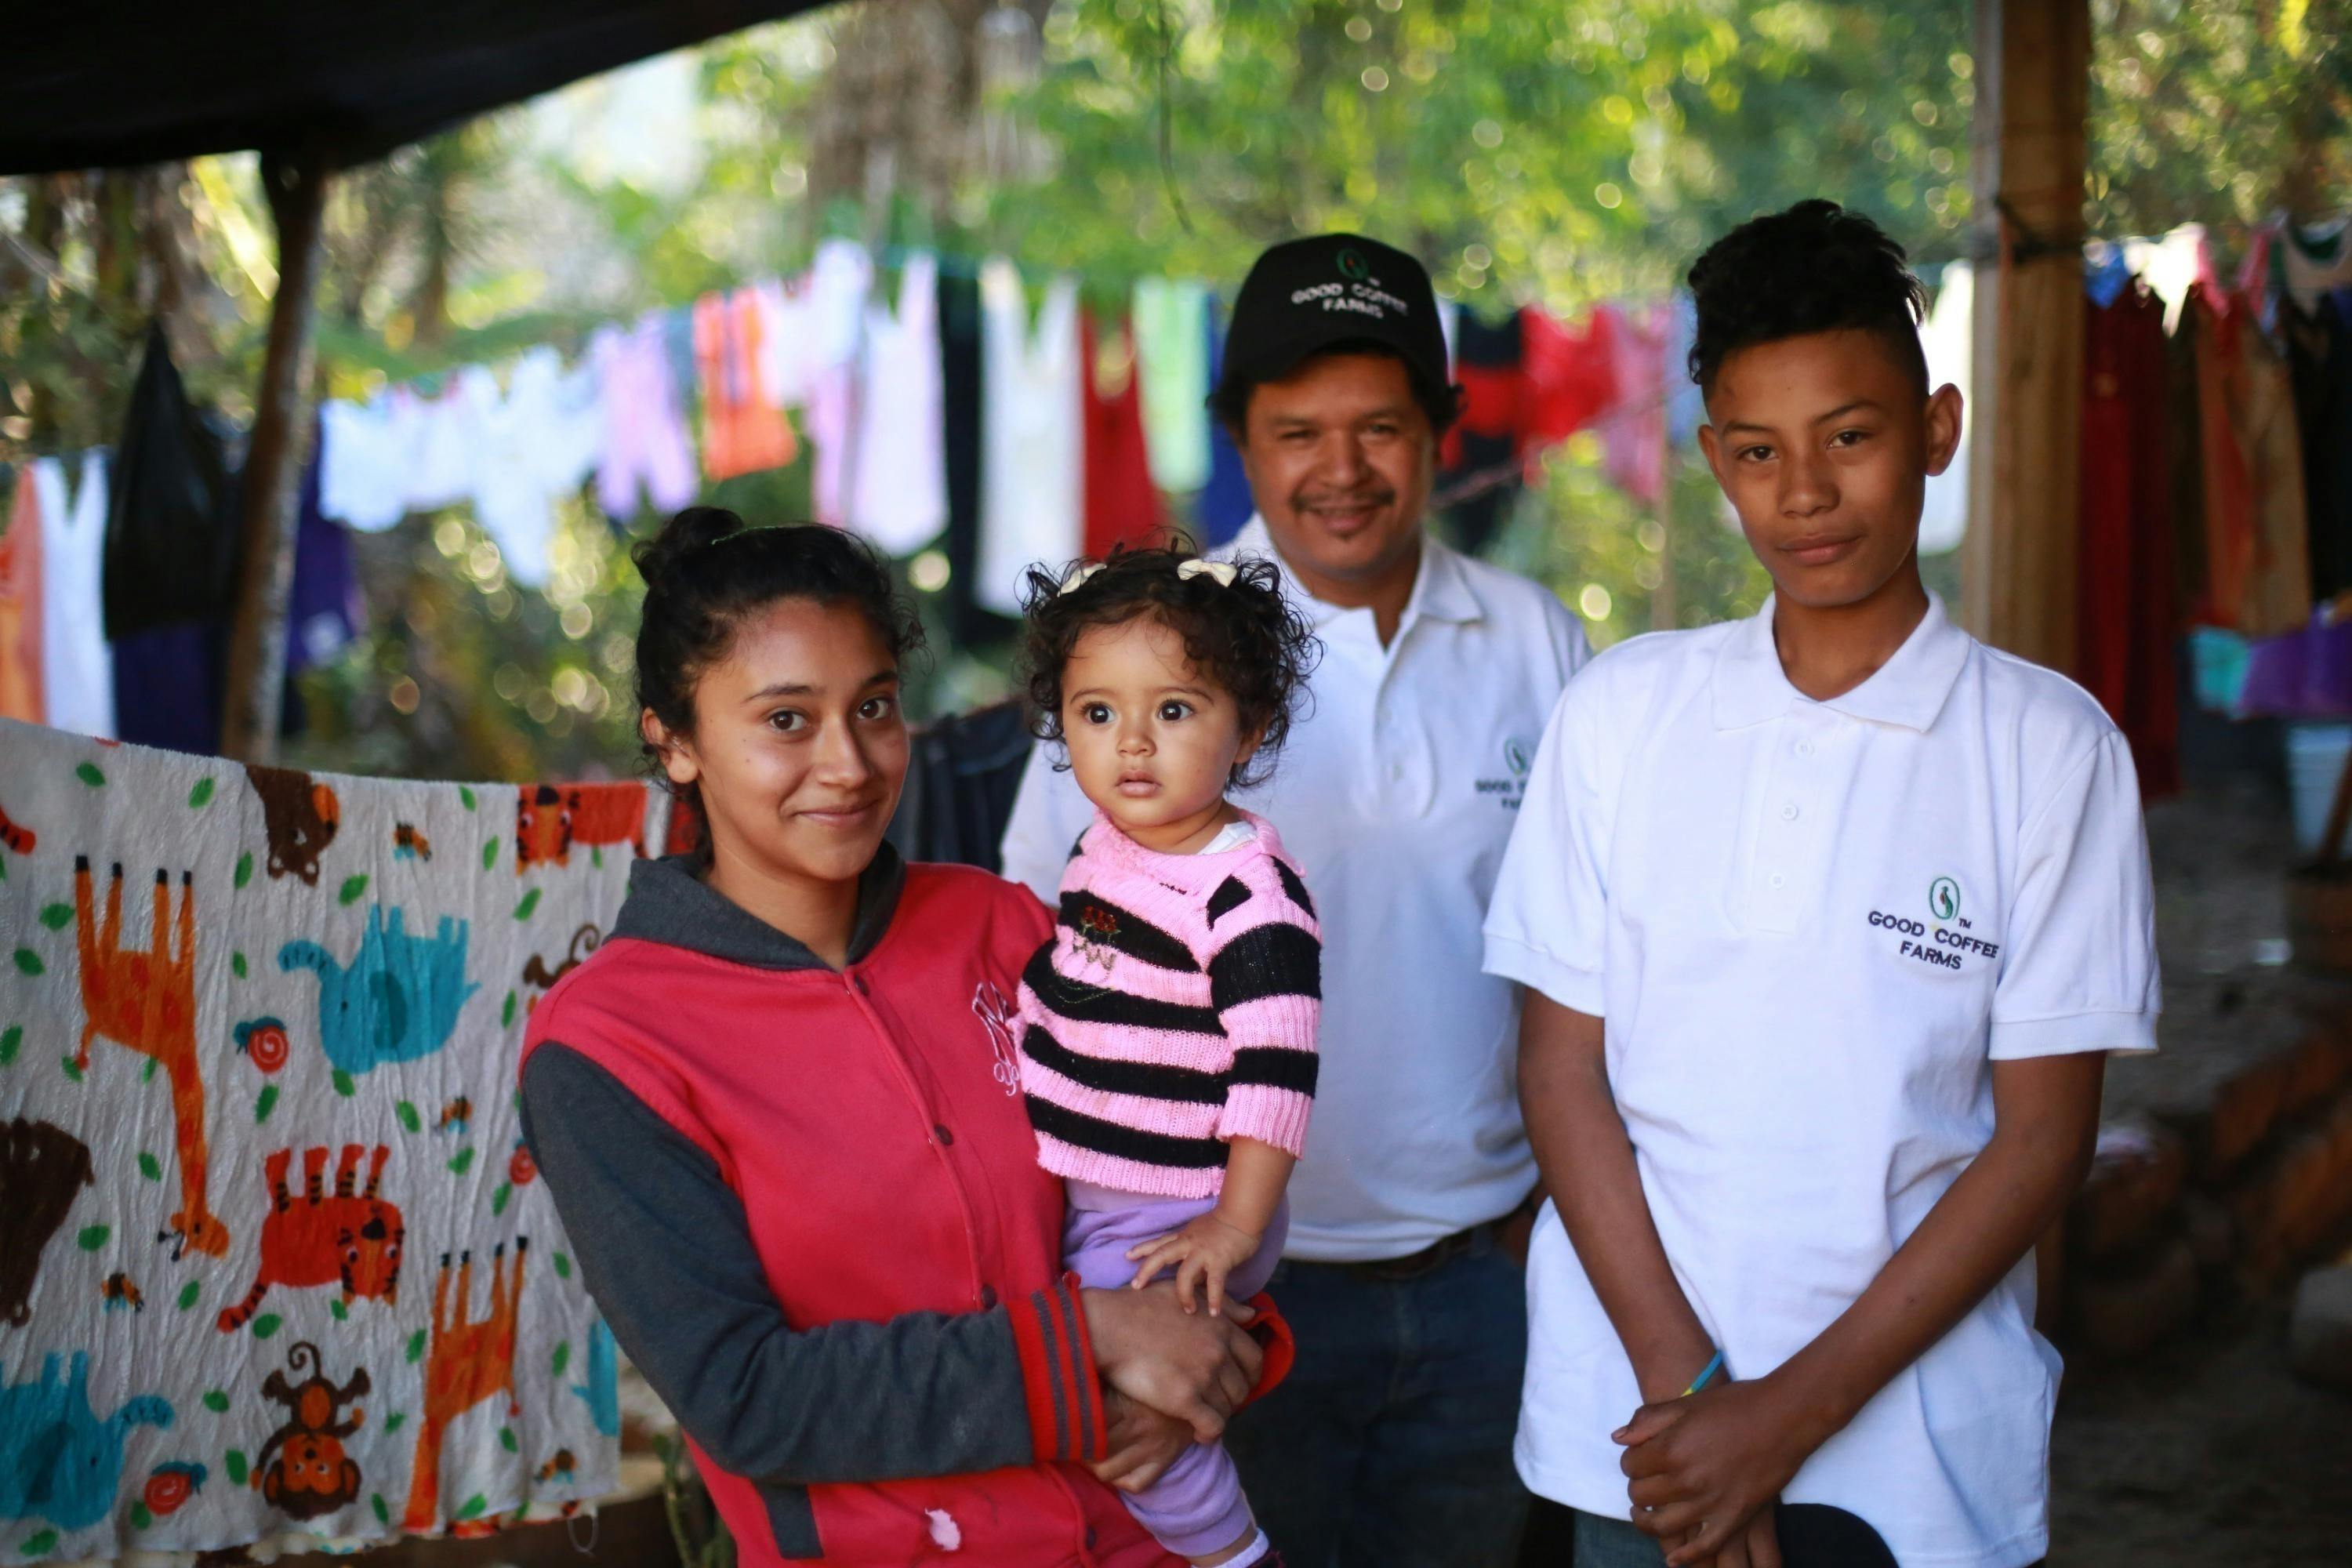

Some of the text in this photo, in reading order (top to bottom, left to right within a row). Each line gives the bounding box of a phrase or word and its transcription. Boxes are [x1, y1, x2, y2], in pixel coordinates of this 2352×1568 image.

[1291, 282, 1343, 304] GOOD
[1323, 298, 1384, 318] FARMS
[1868, 910, 1999, 959] GOOD COFFEE
[1900, 940, 1962, 970] FARMS
